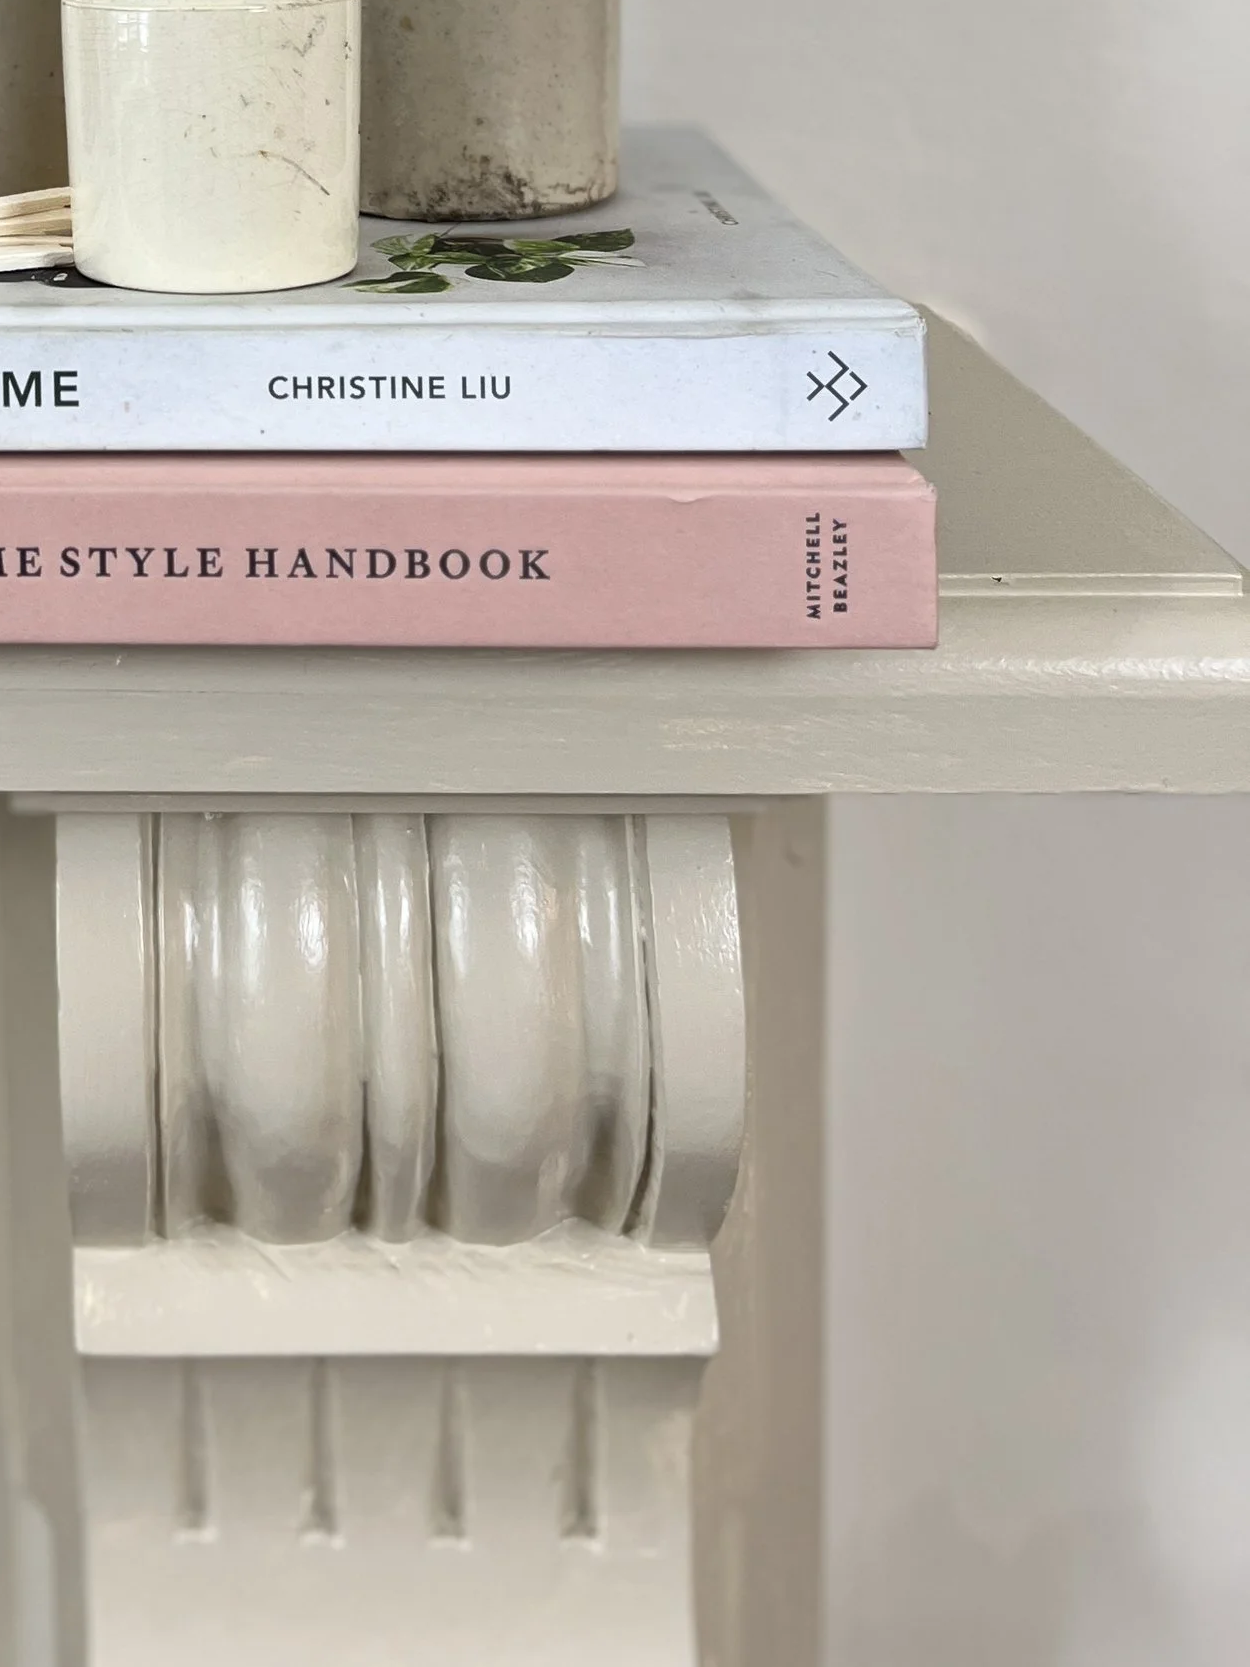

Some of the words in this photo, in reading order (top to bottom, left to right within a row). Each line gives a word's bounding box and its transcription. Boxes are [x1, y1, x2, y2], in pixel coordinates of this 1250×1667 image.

[268, 375, 446, 400] CHRISTINE
[461, 375, 511, 400] LIU
[60, 546, 223, 578] STYLE
[245, 547, 551, 580] HANDBOOK
[805, 512, 821, 620] MITCHELL
[832, 518, 848, 613] BEAZLEY
